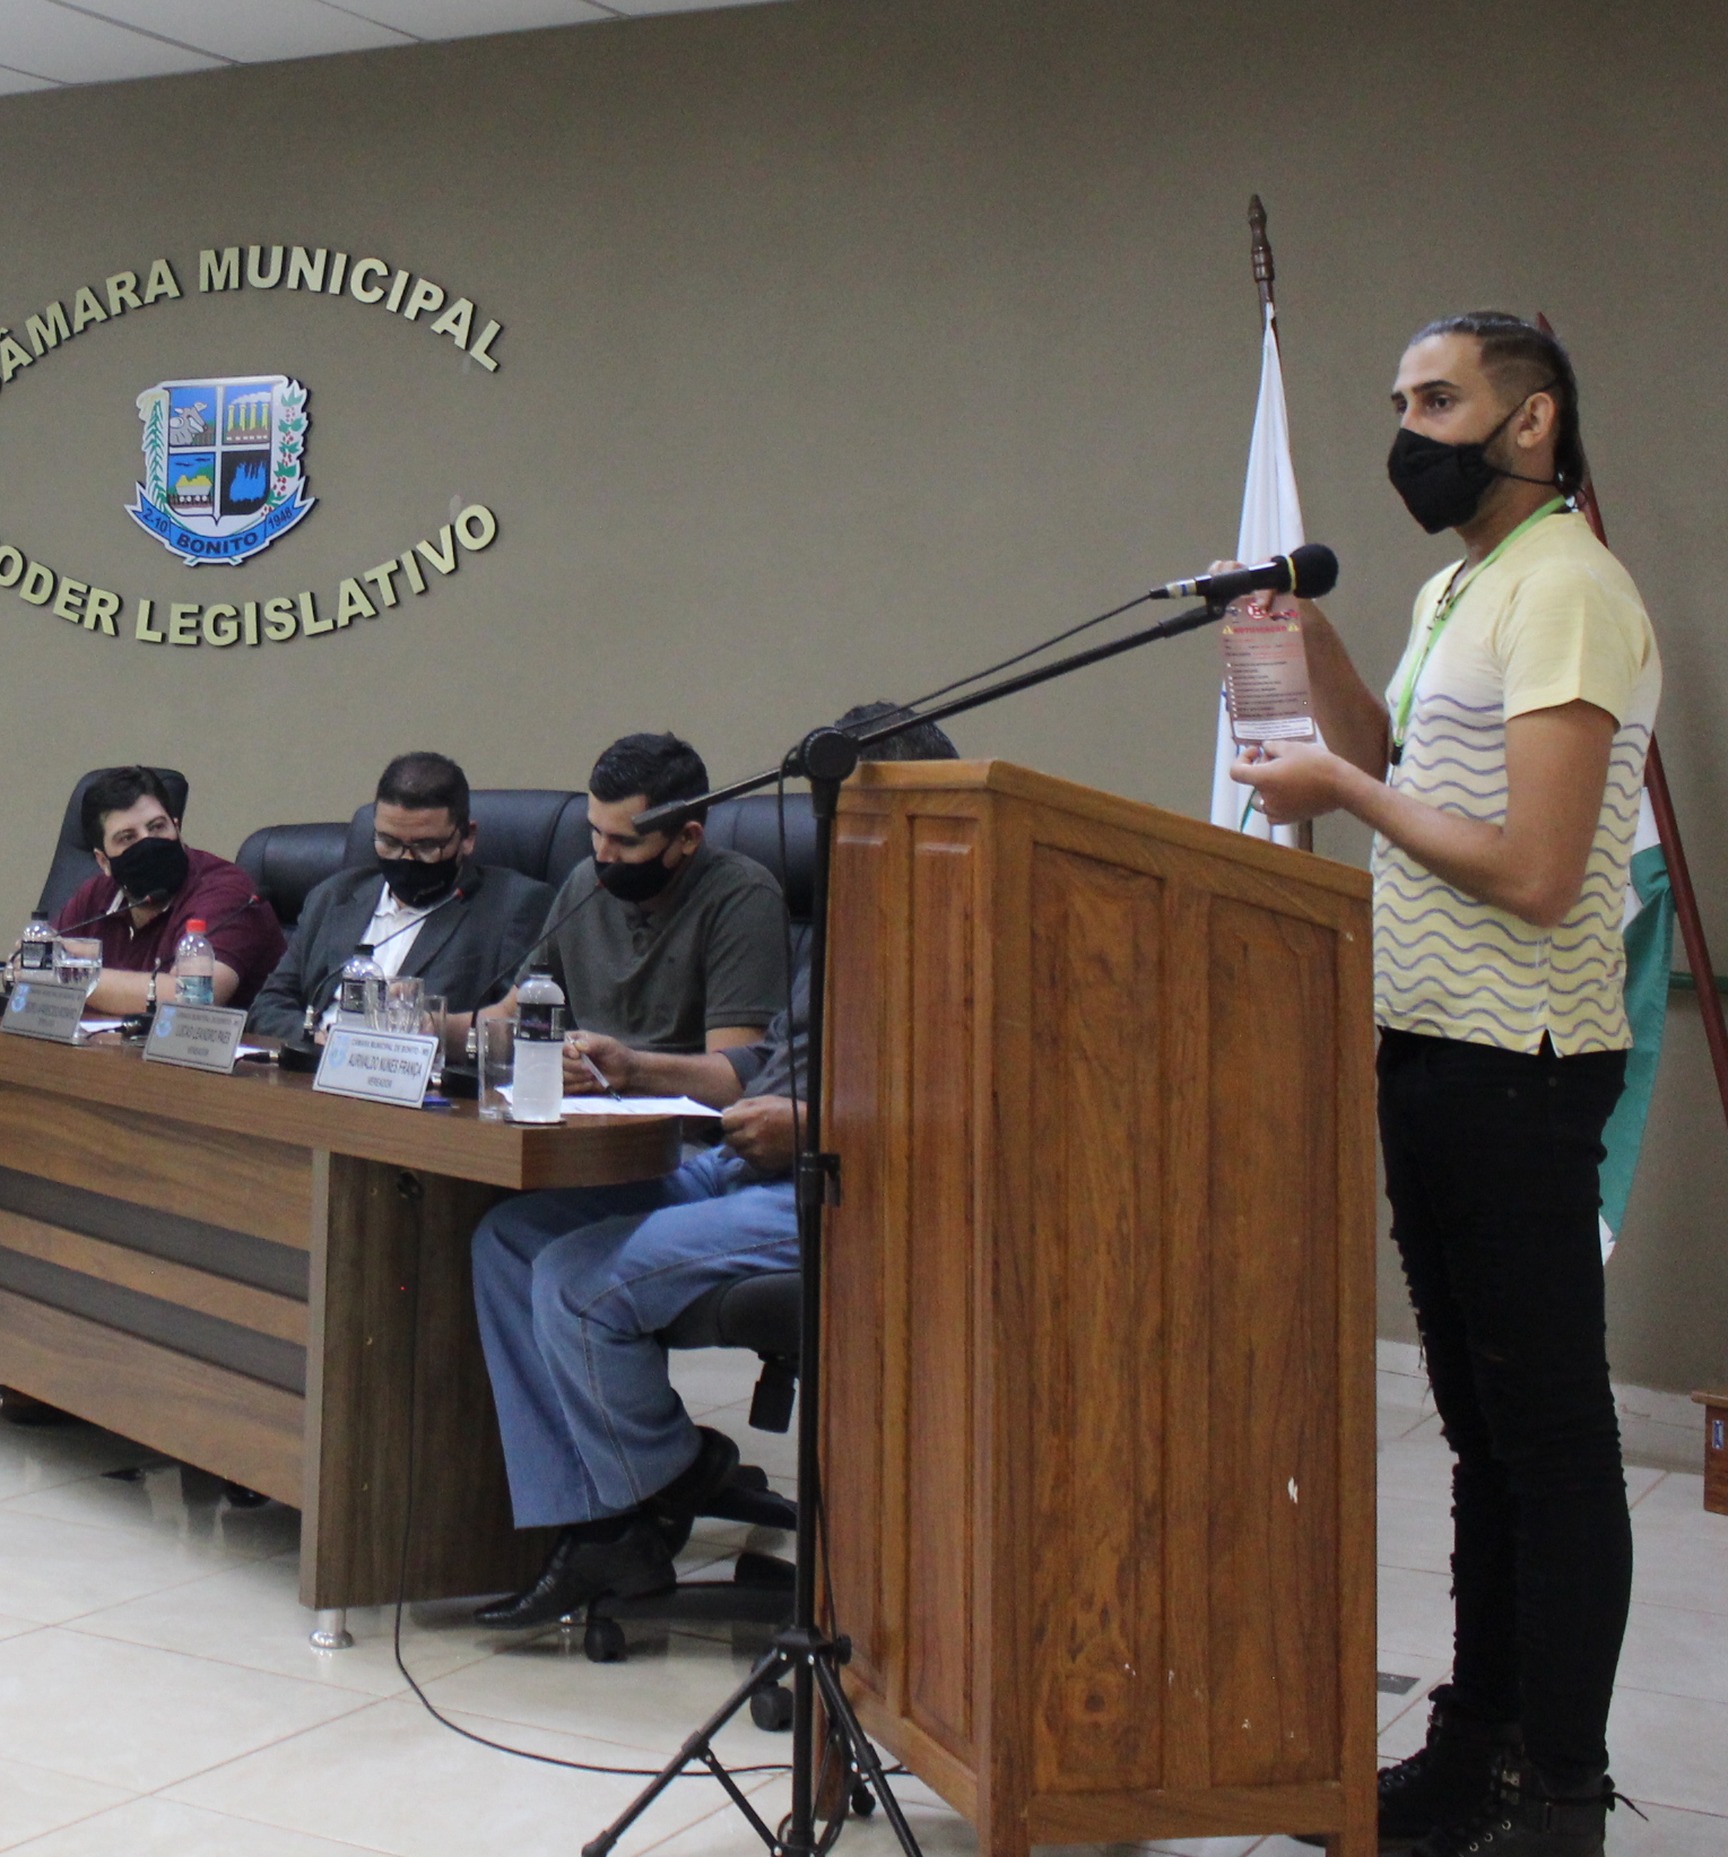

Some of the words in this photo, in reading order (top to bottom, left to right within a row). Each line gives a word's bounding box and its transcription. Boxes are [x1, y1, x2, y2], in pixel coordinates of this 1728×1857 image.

[199, 245, 504, 373] MUNICIPAL
[176, 532, 258, 554] BONITO
[268, 508, 293, 530] 1948
[135, 503, 498, 647] LEGISLATIVO
